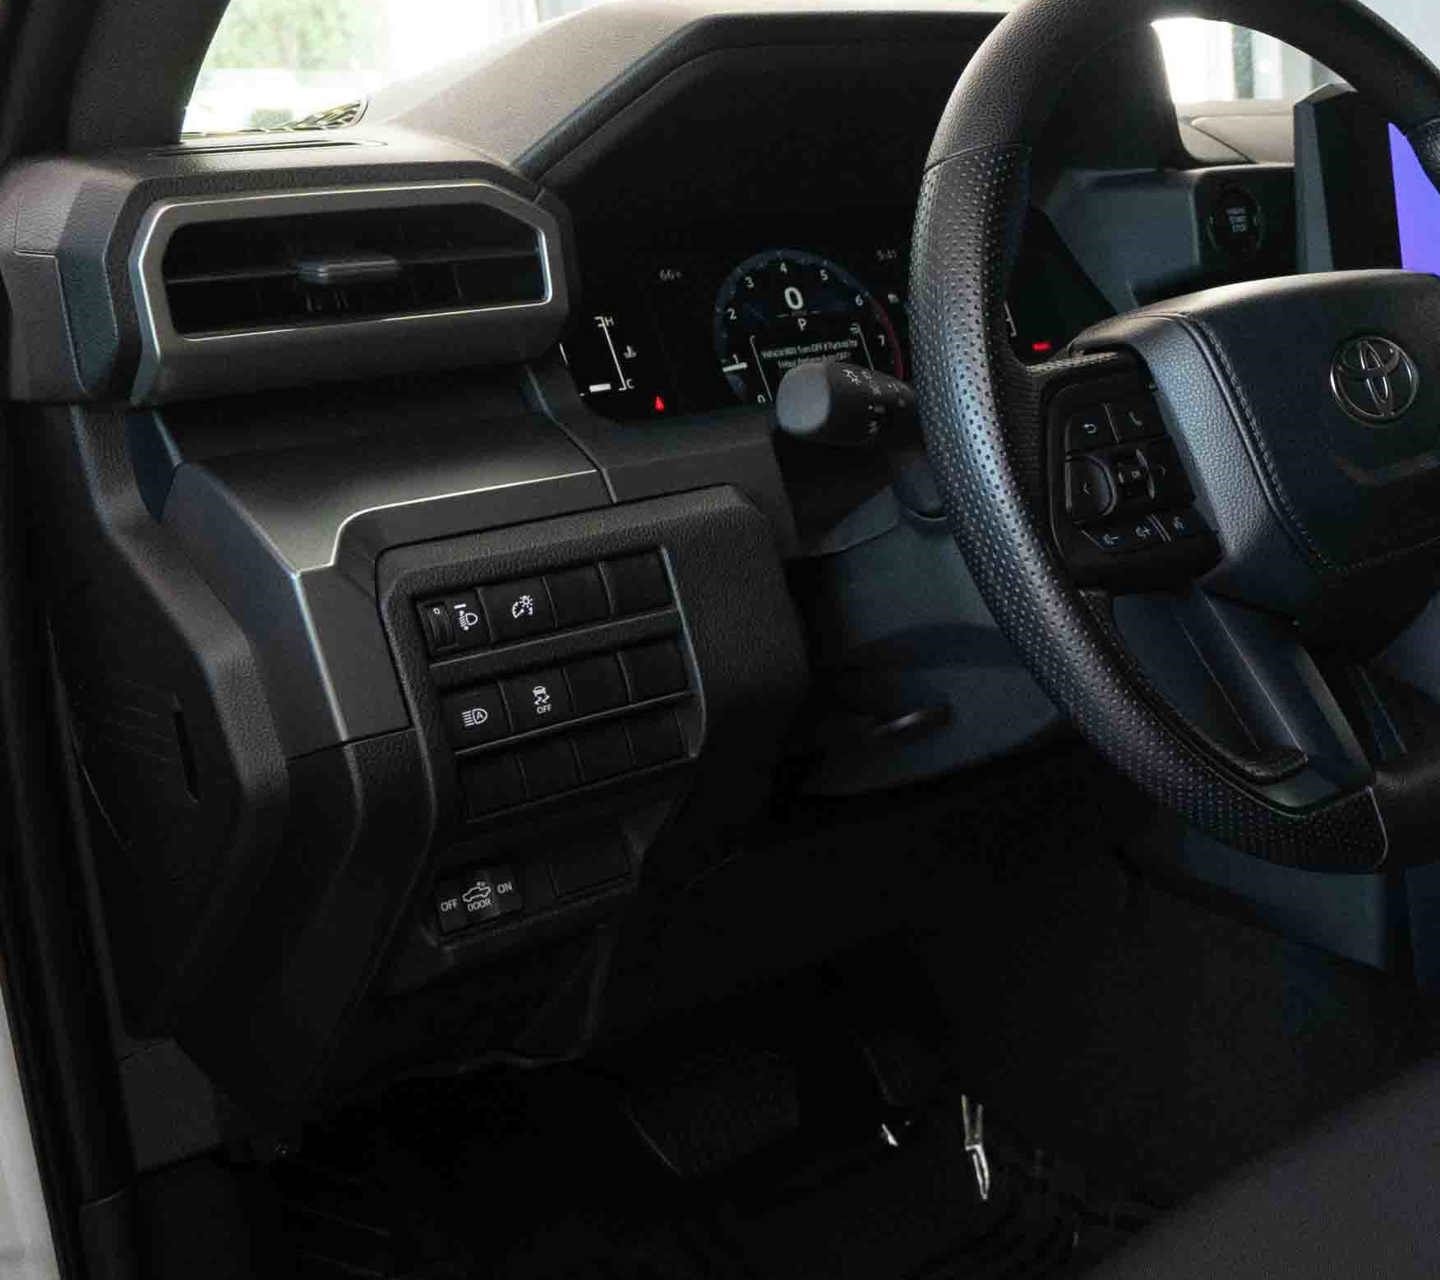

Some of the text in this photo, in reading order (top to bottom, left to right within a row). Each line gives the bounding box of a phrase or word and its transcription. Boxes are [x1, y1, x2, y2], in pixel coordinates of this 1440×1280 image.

[784, 286, 804, 310] 0
[536, 703, 552, 715] OFF
[496, 880, 513, 895] ON
[440, 898, 458, 913] OFF
